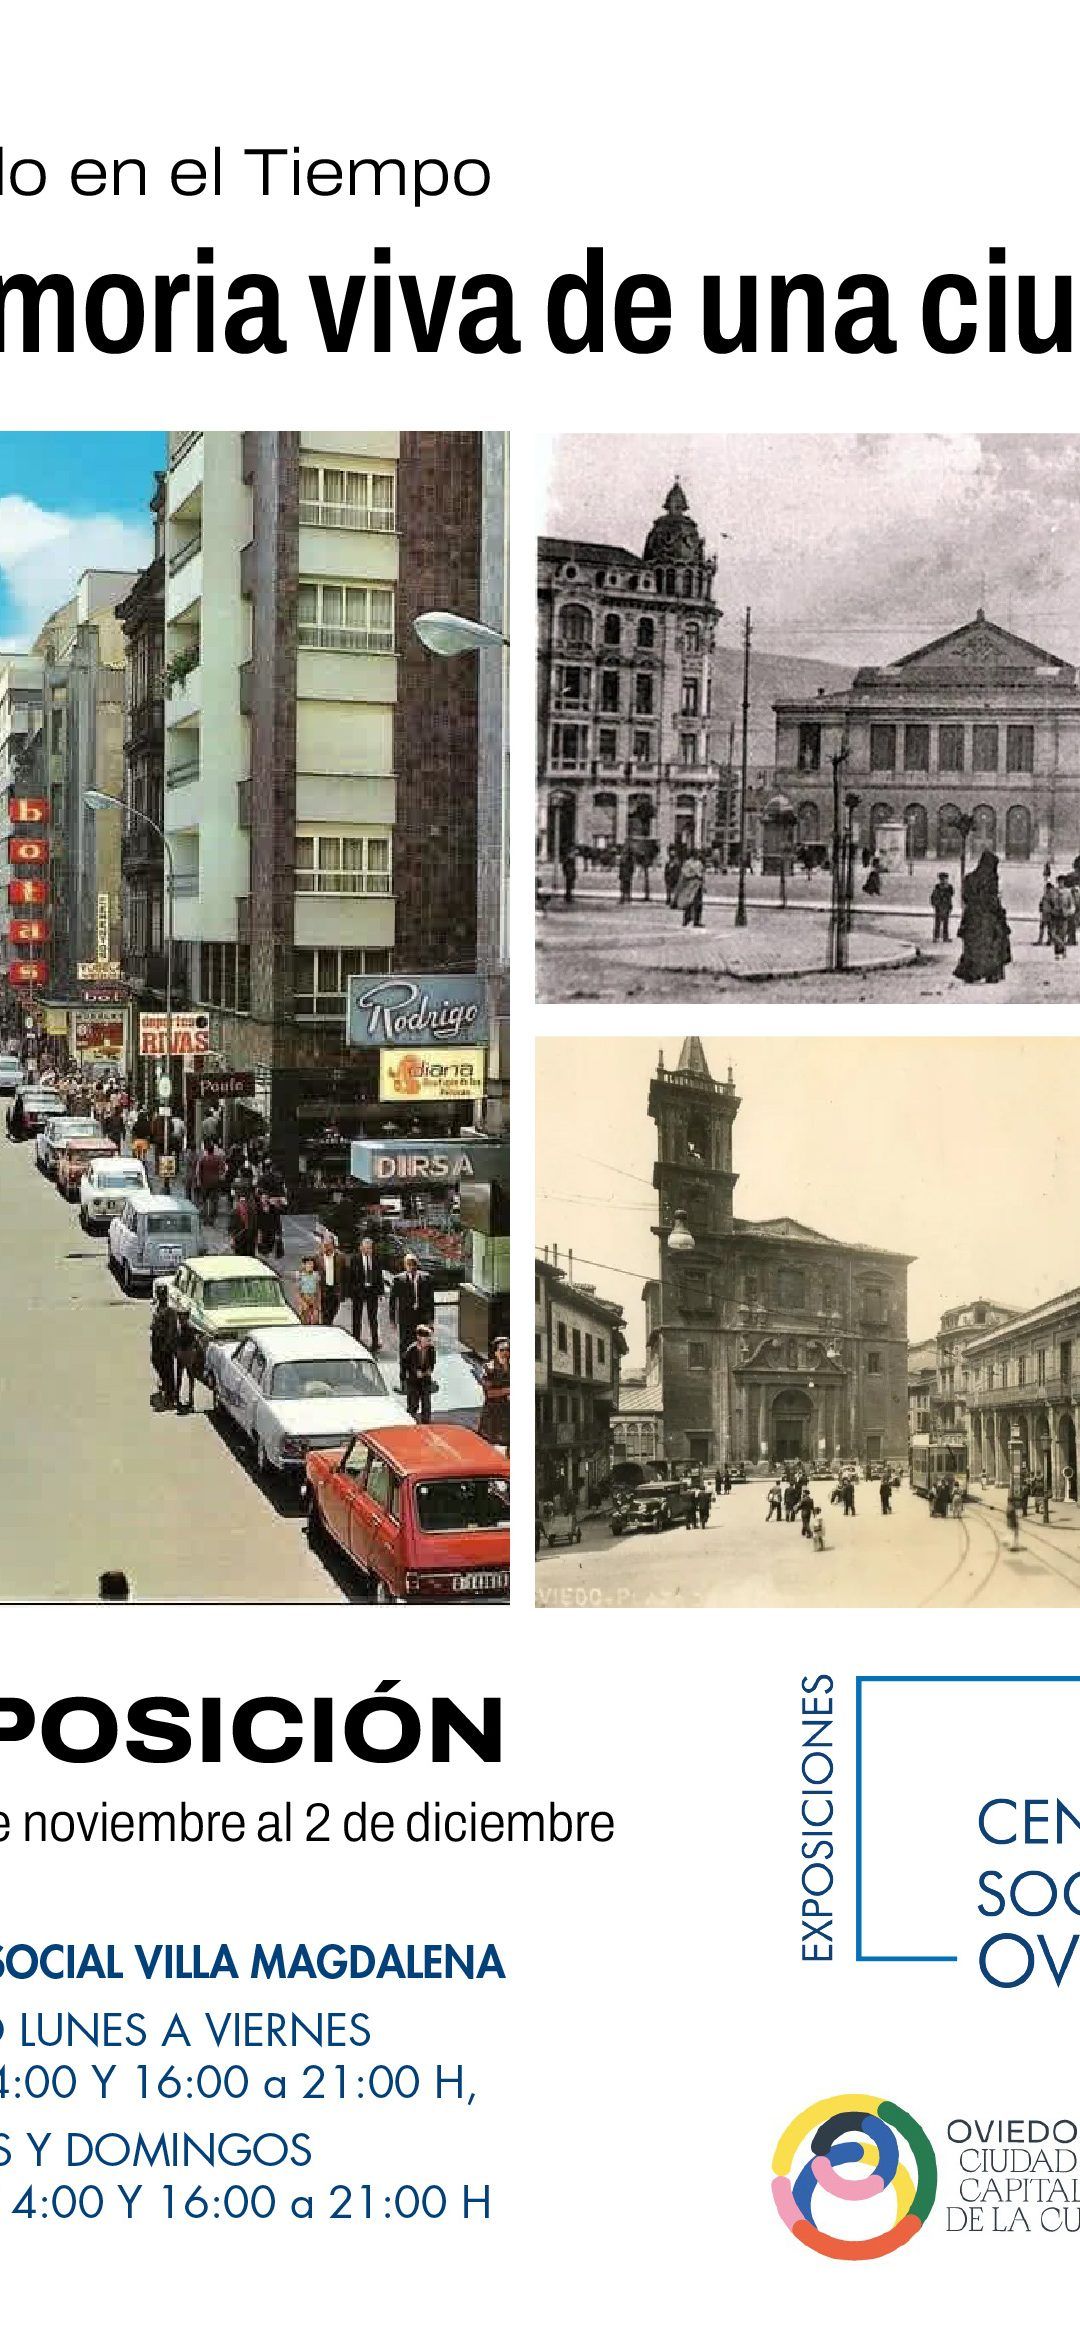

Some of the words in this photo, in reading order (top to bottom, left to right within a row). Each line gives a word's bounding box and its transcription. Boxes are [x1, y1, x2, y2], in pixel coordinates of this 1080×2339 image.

[71, 159, 145, 196] en
[171, 146, 220, 196] el
[244, 147, 490, 207] Tiempo
[0, 247, 287, 354] moria
[309, 247, 521, 354] viva
[548, 247, 671, 354] de
[704, 274, 897, 354] una
[923, 247, 1071, 354] ciu
[359, 981, 478, 1039] Rodrigo
[376, 1153, 475, 1179] DIRSA
[25, 1802, 245, 1842] noviembre
[258, 1802, 290, 1842] al
[306, 1803, 329, 1841] 2
[344, 1802, 394, 1842] de
[407, 1802, 614, 1842] diciembre
[802, 1675, 834, 1960] EXPOSICIONES
[0, 1944, 123, 1979] OCIAL
[135, 1944, 239, 1979] VILLA
[251, 1944, 506, 1979] MAGDALENA
[979, 1933, 1080, 1988] OV
[22, 2012, 146, 2047] LUNES
[162, 2012, 191, 2047] A
[205, 2012, 370, 2047] VIERNES
[91, 2065, 116, 2098] Y
[137, 2065, 248, 2098] 16:00
[265, 2077, 285, 2098] a
[303, 2065, 419, 2098] 21:00
[437, 2065, 475, 2105] H,
[947, 2118, 1078, 2144] OVIEDO
[27, 2133, 51, 2166] Y
[68, 2132, 311, 2167] DOMINGOS
[959, 2148, 1078, 2173] CIUDAD
[12, 2185, 103, 2218] 4:00
[118, 2185, 142, 2218] Y
[163, 2185, 275, 2218] 16:00
[291, 2197, 312, 2218] a
[330, 2185, 446, 2218] 21:00
[464, 2185, 489, 2218] H
[946, 2207, 984, 2232] DE
[992, 2207, 1031, 2232] LA
